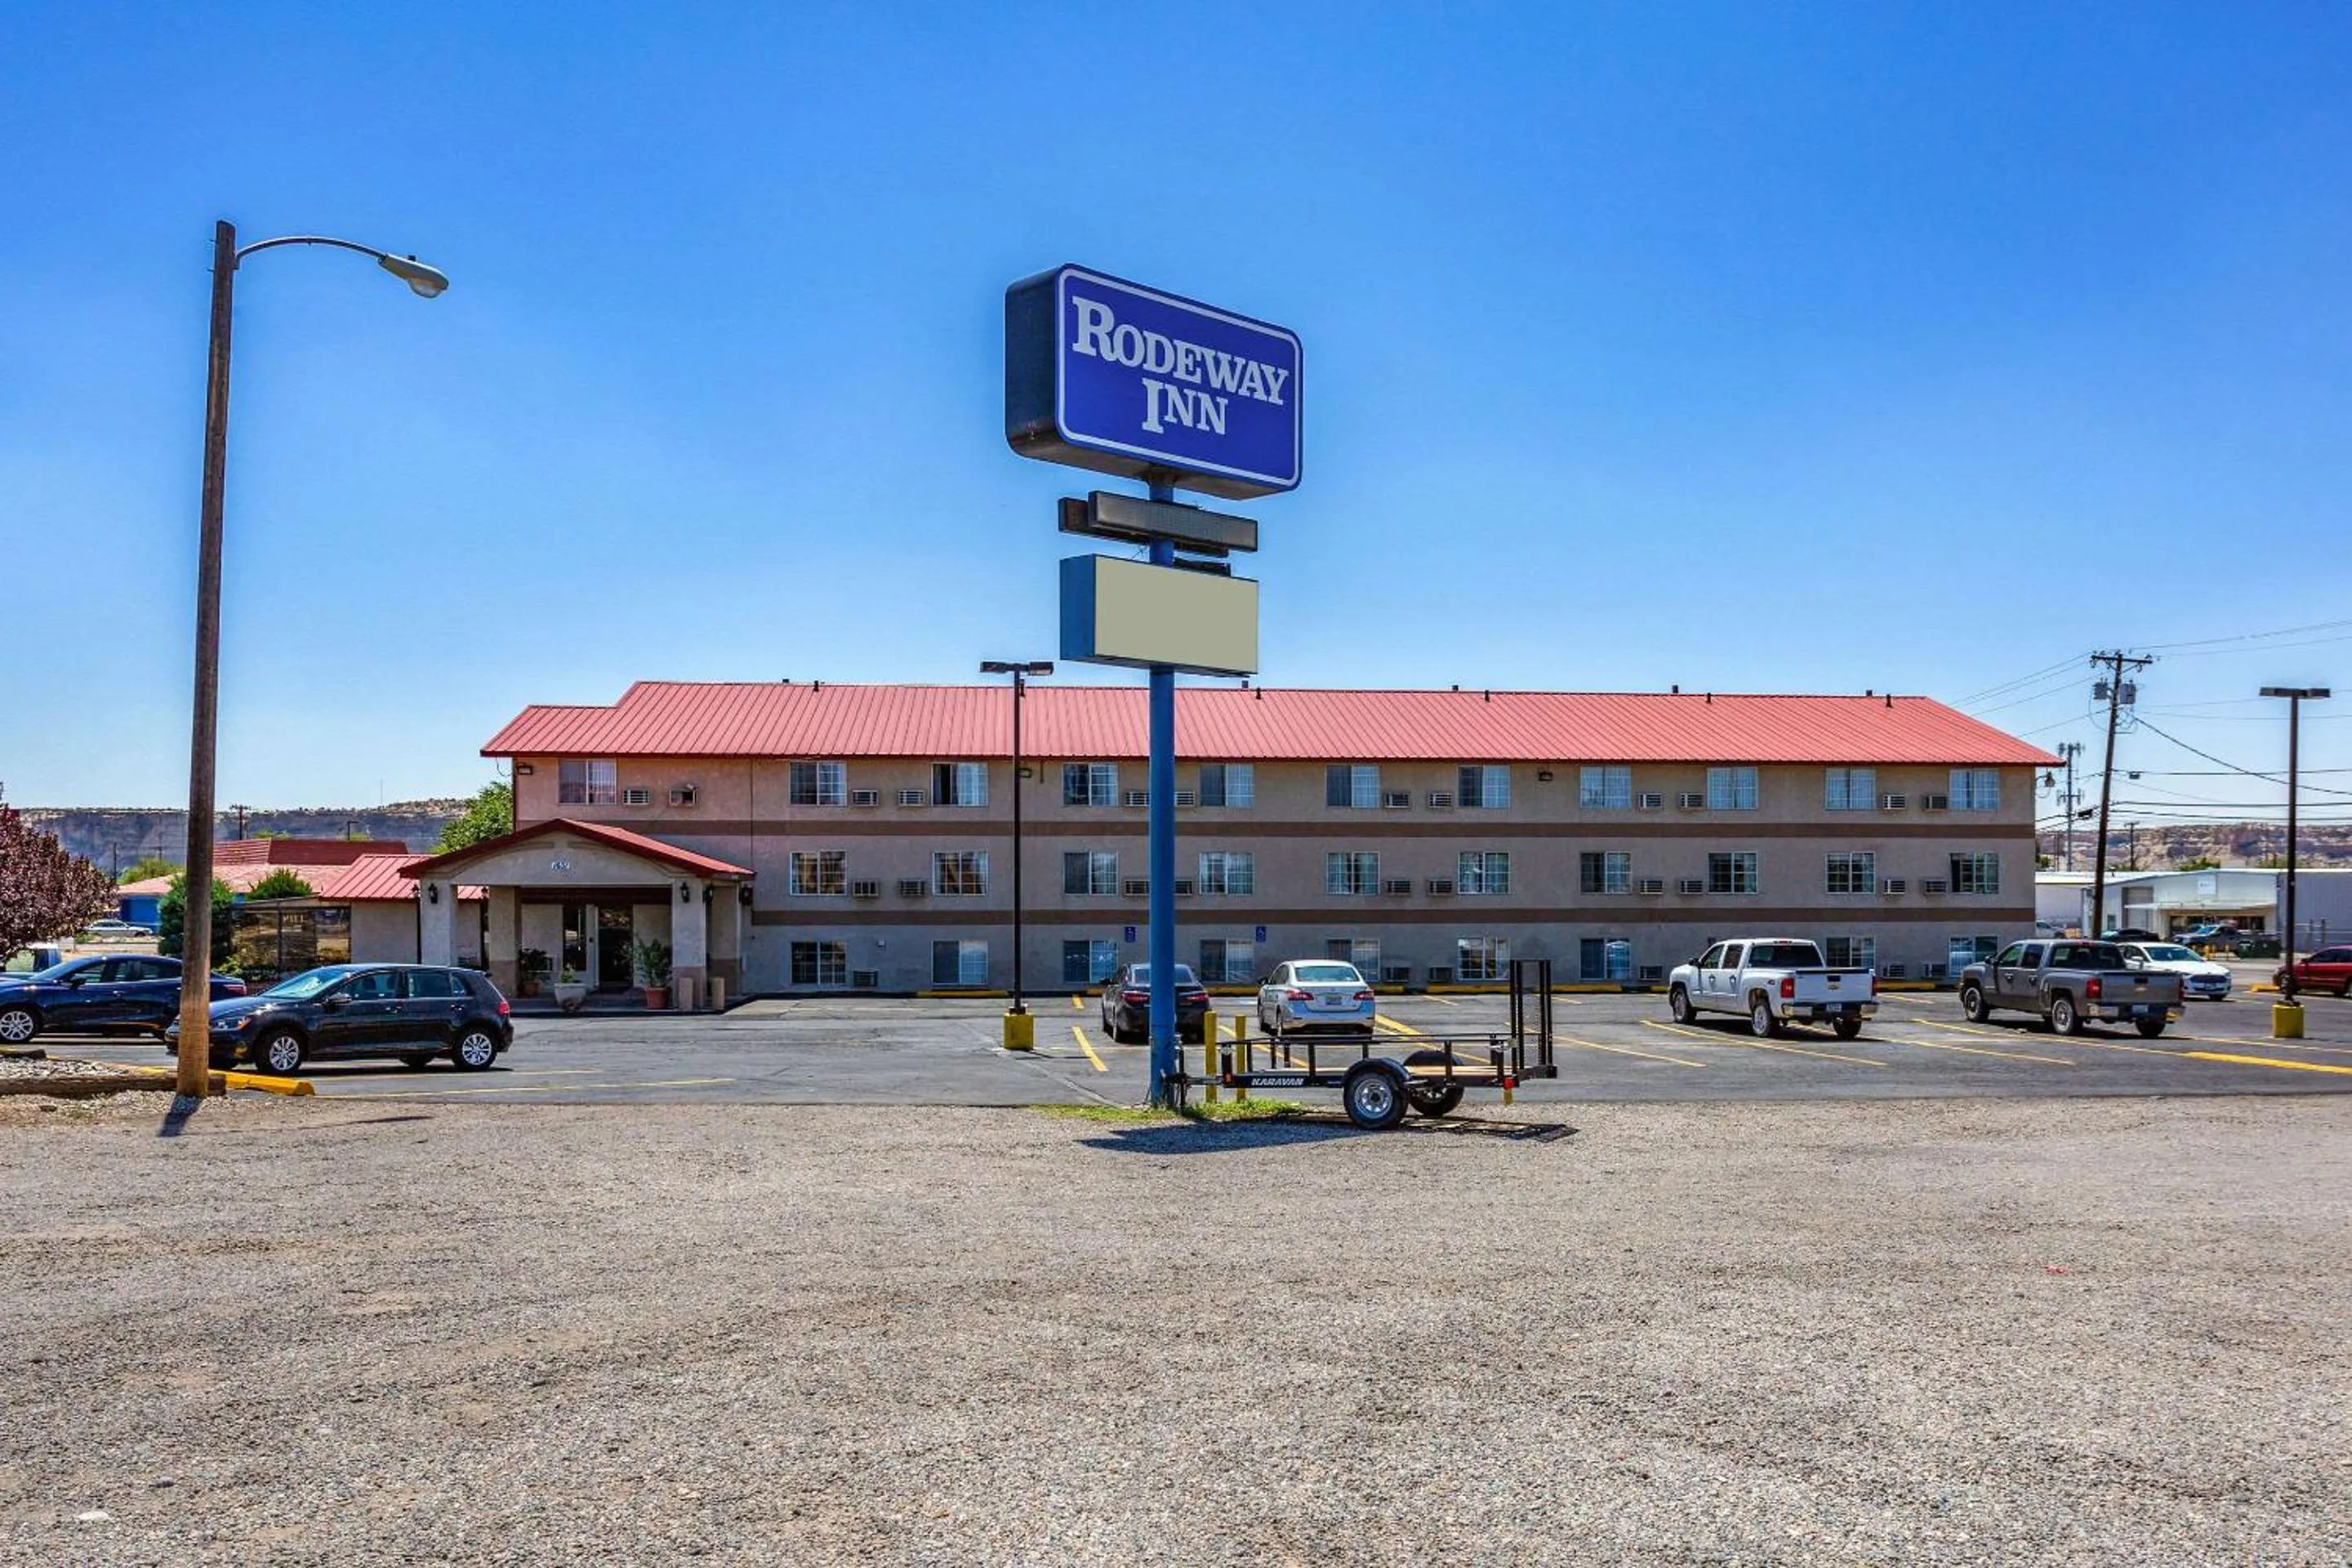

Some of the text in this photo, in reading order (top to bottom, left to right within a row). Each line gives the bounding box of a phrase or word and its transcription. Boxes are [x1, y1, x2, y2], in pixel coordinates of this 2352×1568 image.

[1071, 296, 1289, 405] RODEWAY
[1142, 377, 1228, 434] INN
[1251, 1078, 1304, 1086] KARAVAN
